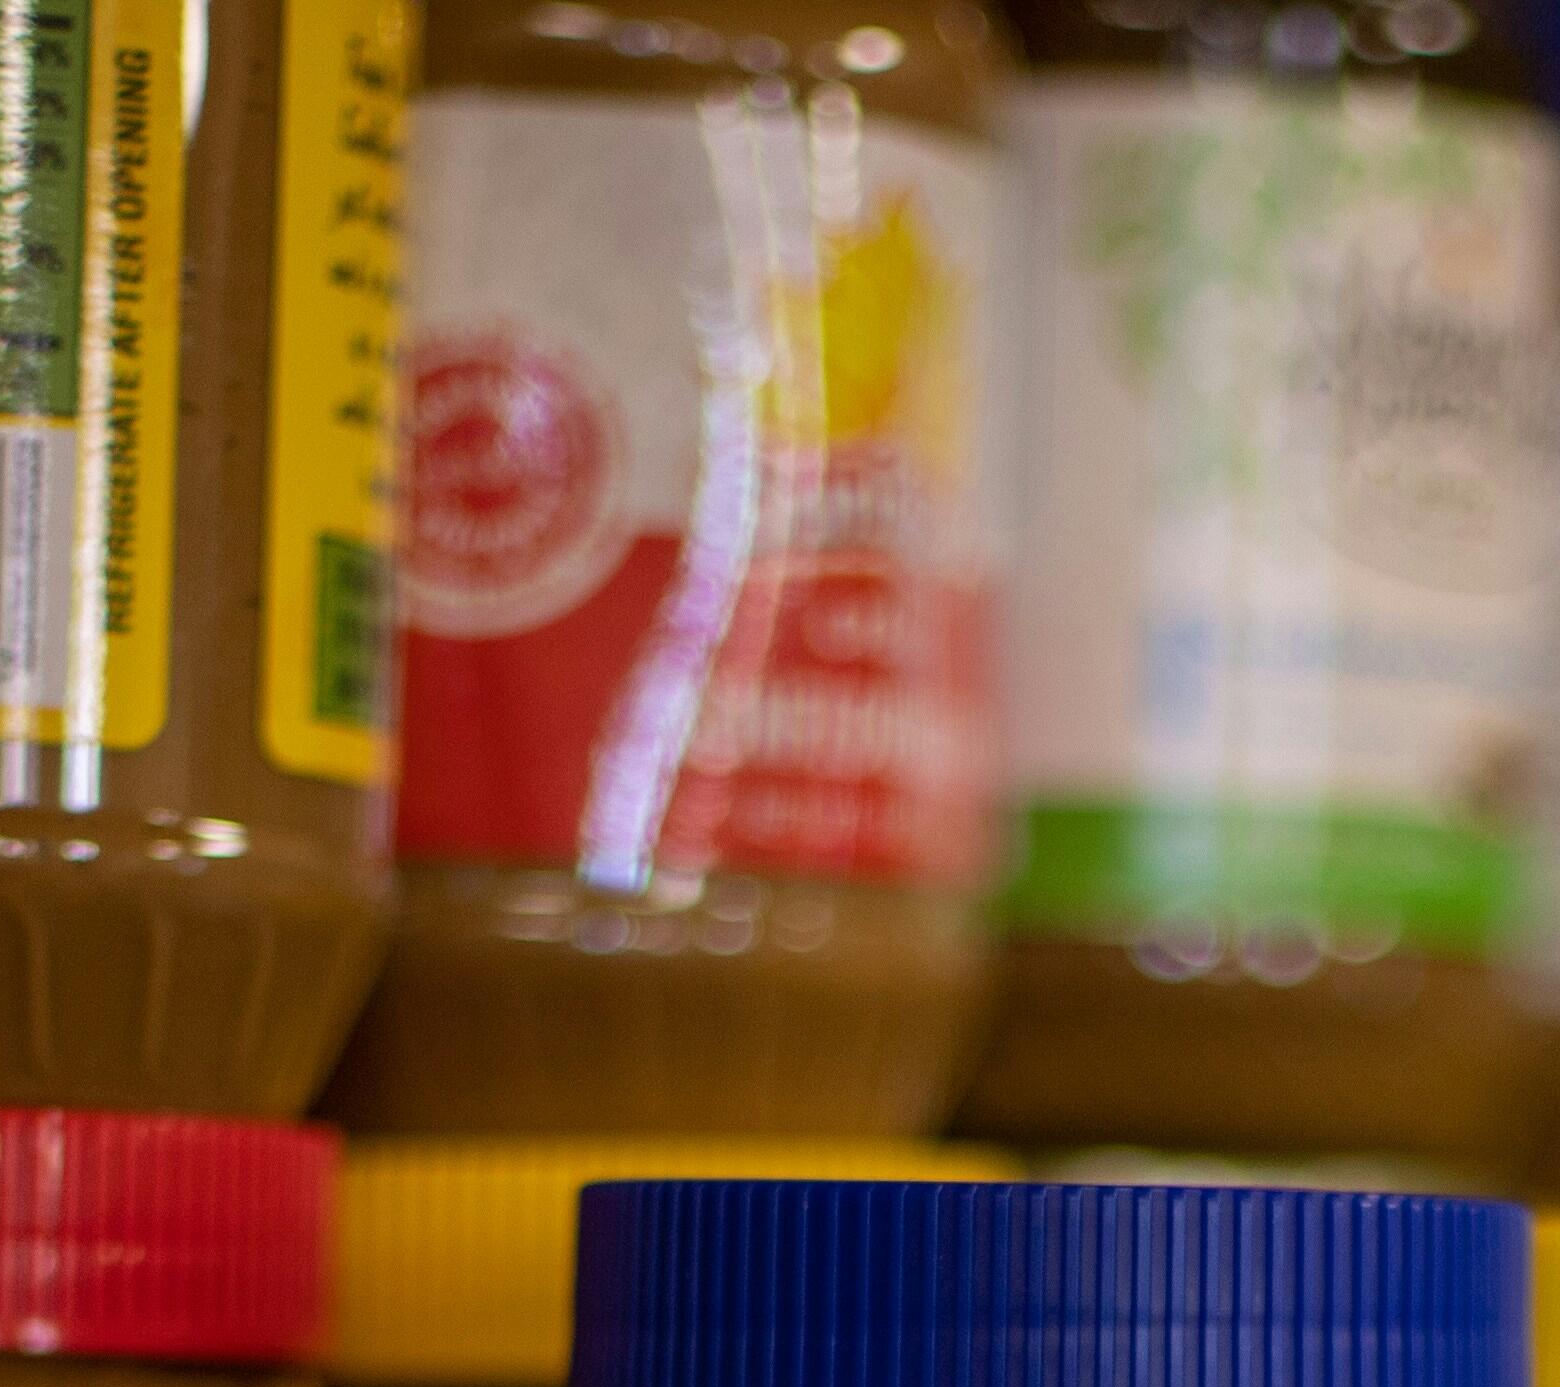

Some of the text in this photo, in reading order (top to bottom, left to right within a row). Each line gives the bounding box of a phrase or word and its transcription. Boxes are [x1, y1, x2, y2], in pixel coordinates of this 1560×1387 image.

[102, 47, 152, 635] REFRIGERATE AFTER OPENING
